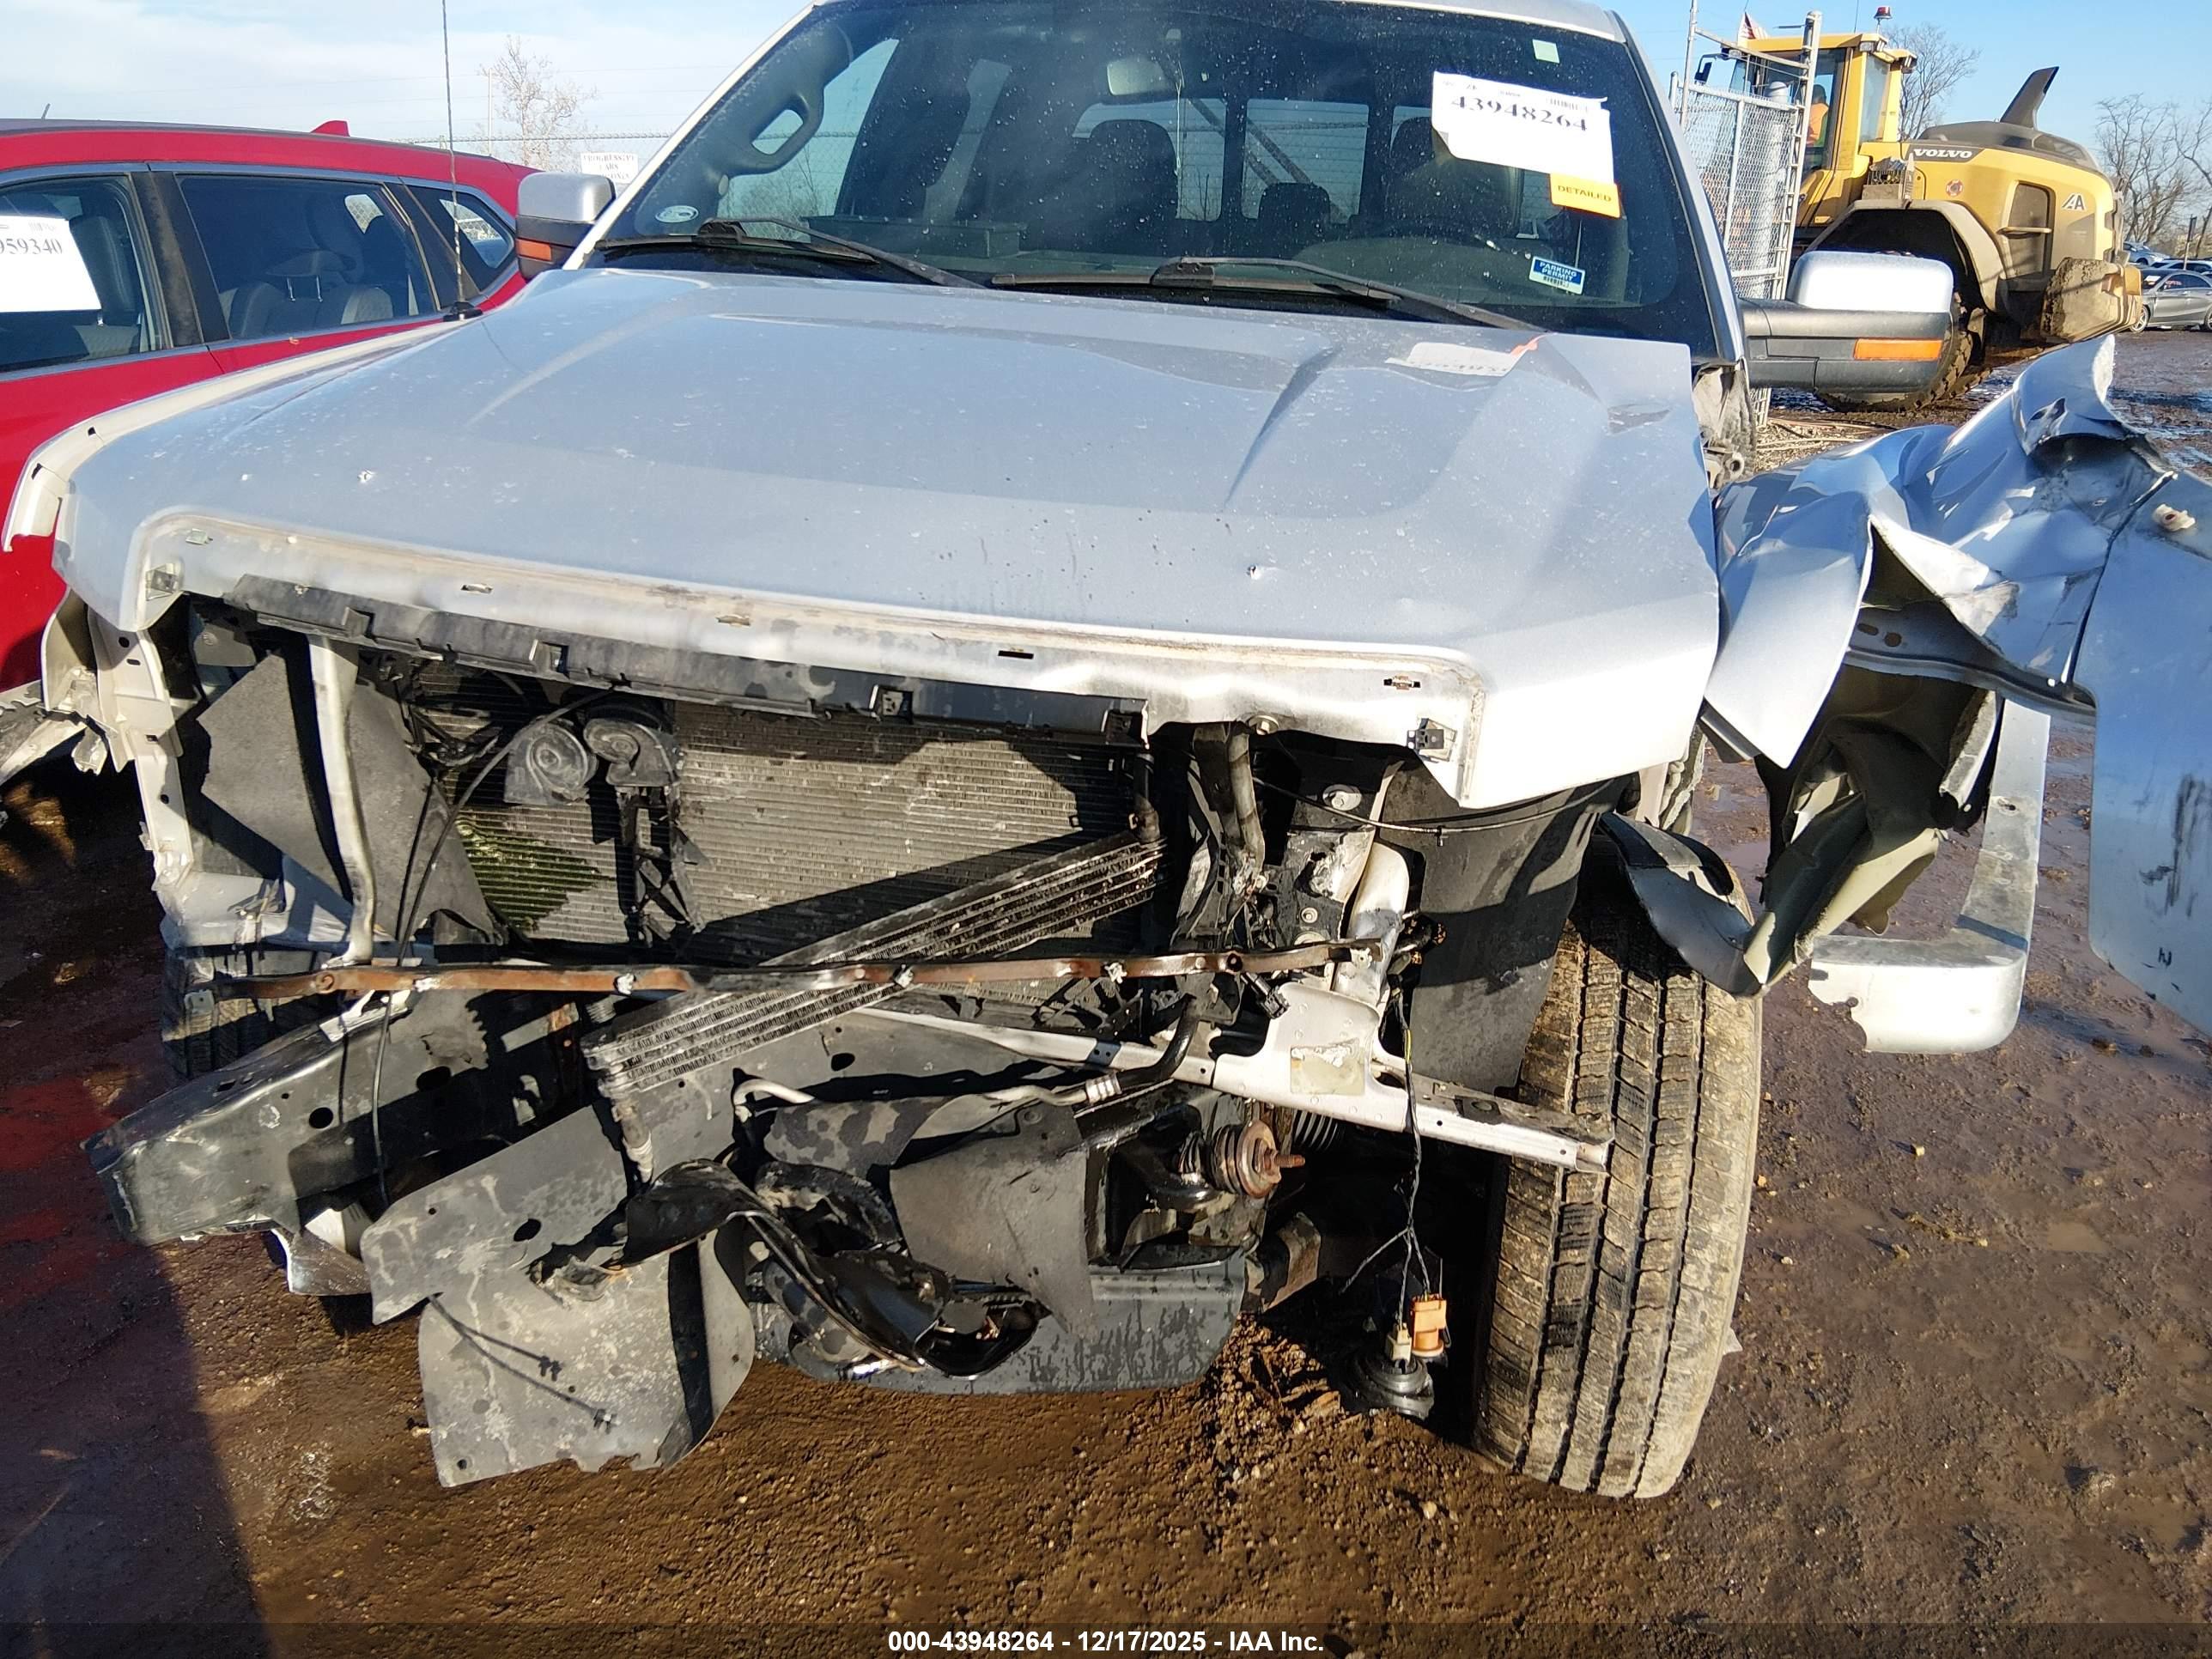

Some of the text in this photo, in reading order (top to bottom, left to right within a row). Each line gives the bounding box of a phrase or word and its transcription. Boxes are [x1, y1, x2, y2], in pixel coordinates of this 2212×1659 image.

[1451, 95, 1588, 131] 43948264
[1913, 149, 1972, 159] VOLVO
[1558, 185, 1612, 202] DETAILED
[1540, 261, 1577, 277] PARKING
[1541, 268, 1574, 282] PERMIT
